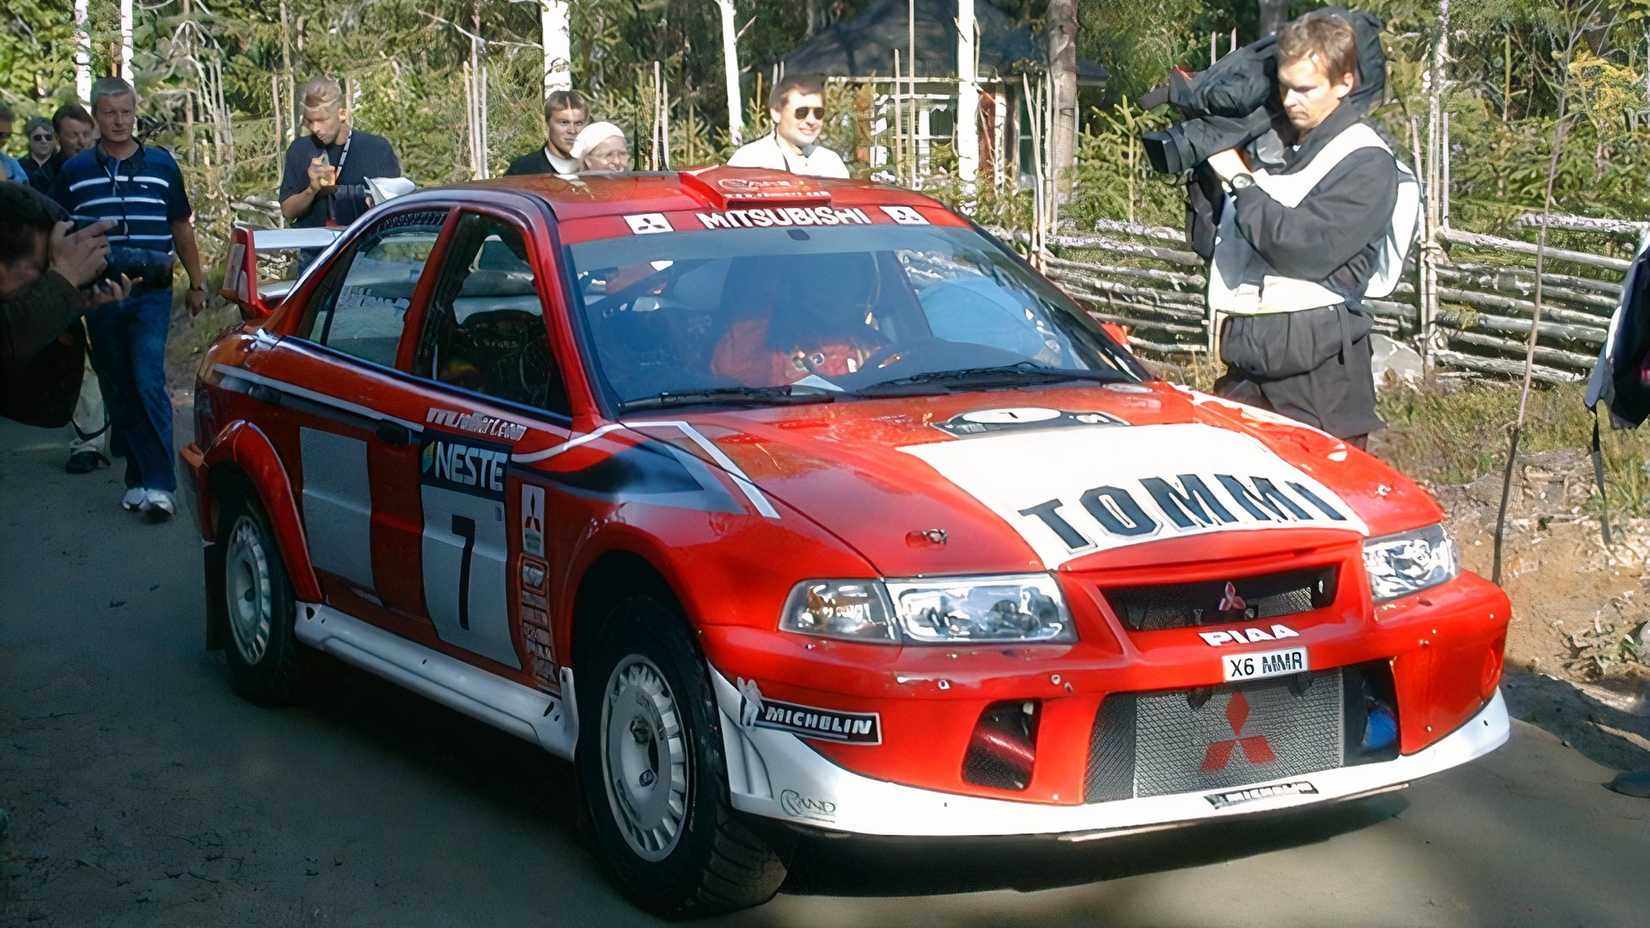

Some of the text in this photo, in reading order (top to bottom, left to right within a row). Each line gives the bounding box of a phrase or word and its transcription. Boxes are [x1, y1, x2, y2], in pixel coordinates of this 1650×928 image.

[695, 207, 872, 230] MITSUBISHI
[434, 441, 508, 492] NESTE
[1017, 474, 1348, 552] TOMMI
[452, 513, 476, 631] 7
[1198, 624, 1300, 647] PIAA
[1230, 658, 1255, 677] X6
